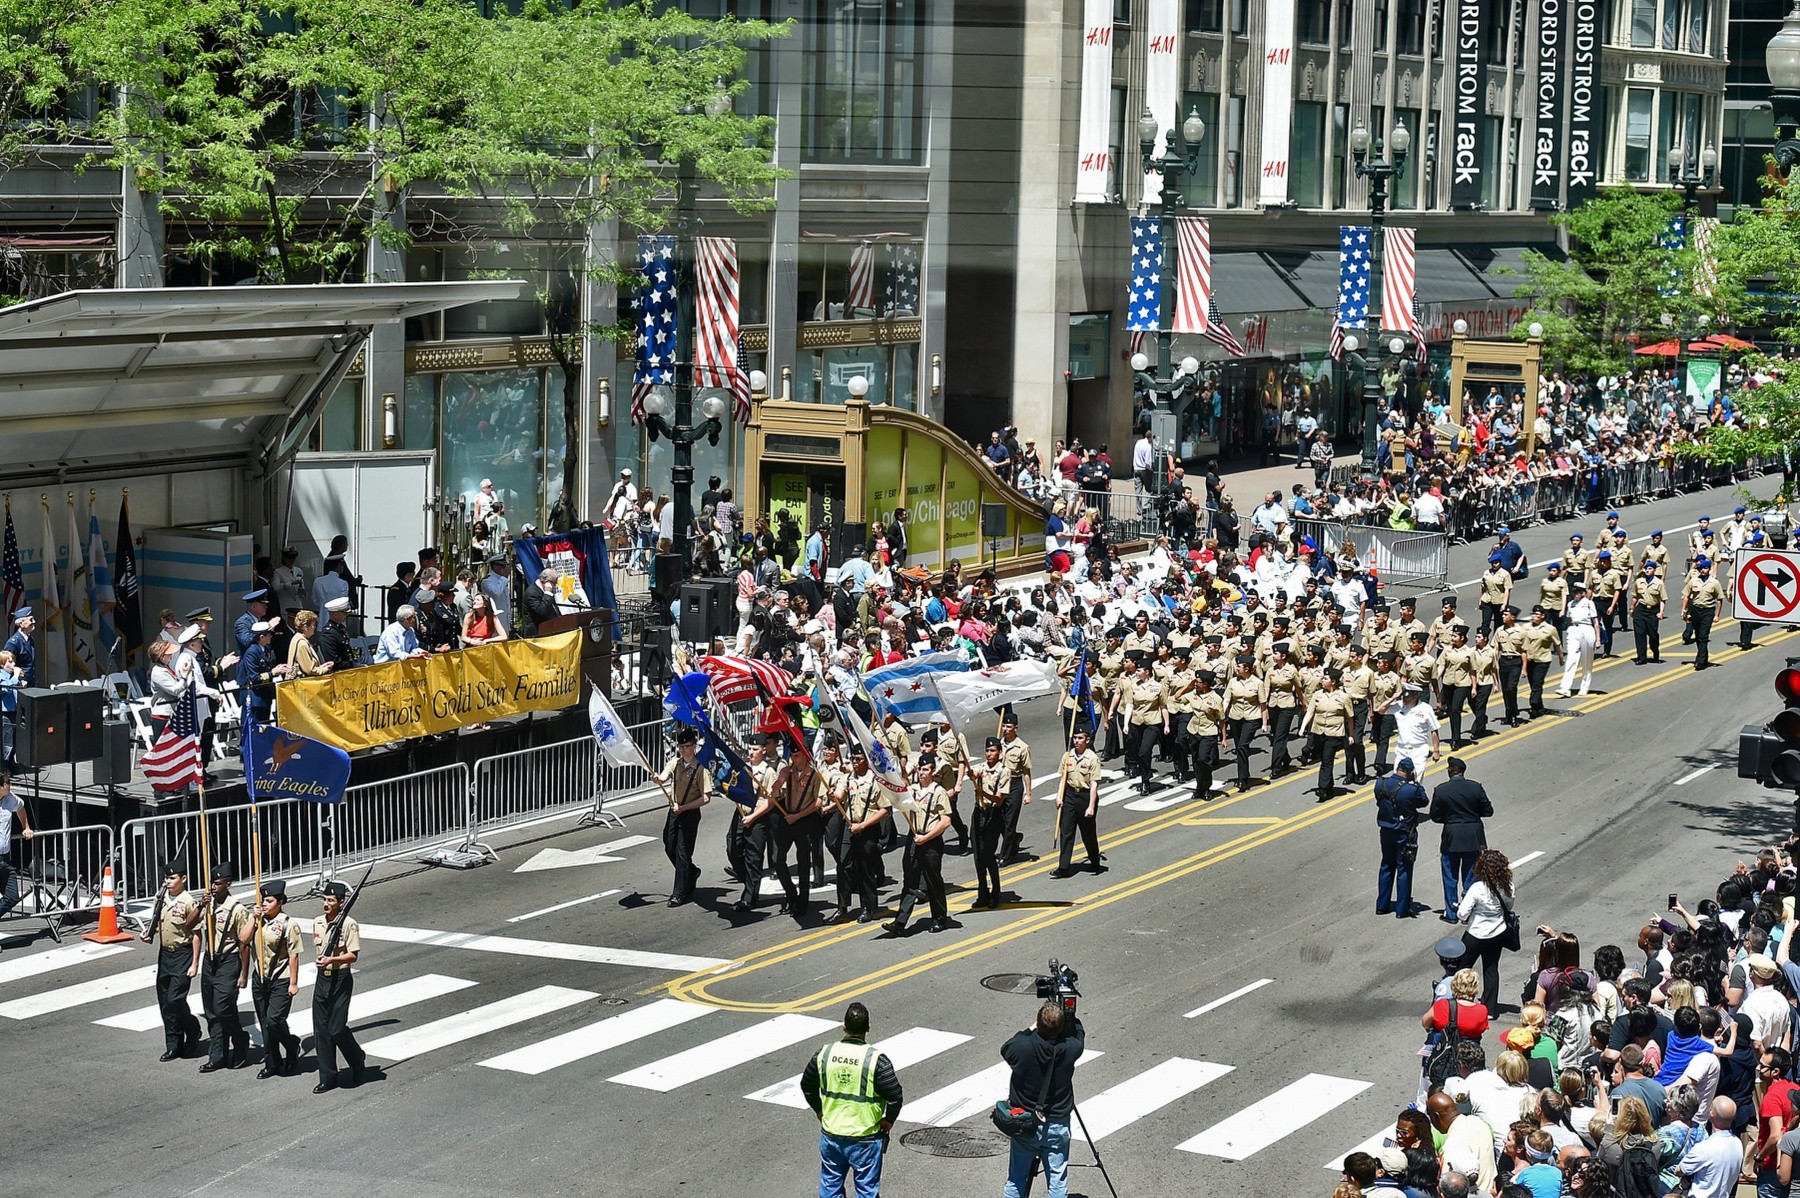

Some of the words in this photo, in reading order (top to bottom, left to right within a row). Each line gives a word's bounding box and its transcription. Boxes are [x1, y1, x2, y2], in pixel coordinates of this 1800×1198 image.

[1086, 27, 1111, 46] H&M
[1150, 35, 1175, 54] H&M
[1266, 48, 1289, 65] H&M
[1458, 0, 1479, 114] RDSTROM
[1572, 0, 1595, 123] ORDSTROM
[1080, 153, 1107, 172] H&M
[1455, 122, 1480, 184] rack
[1535, 127, 1558, 186] rack
[1569, 130, 1594, 187] rack
[1263, 160, 1286, 178] H&M
[785, 481, 803, 493] SEE
[874, 490, 883, 500] SEE
[785, 498, 803, 509] EAT
[773, 511, 803, 525] DNK
[342, 687, 359, 702] City
[370, 680, 399, 695] Chicago
[432, 683, 472, 719] Gold
[476, 681, 508, 709] Star
[278, 777, 330, 797] Eagles
[832, 1056, 859, 1066] DCASE
